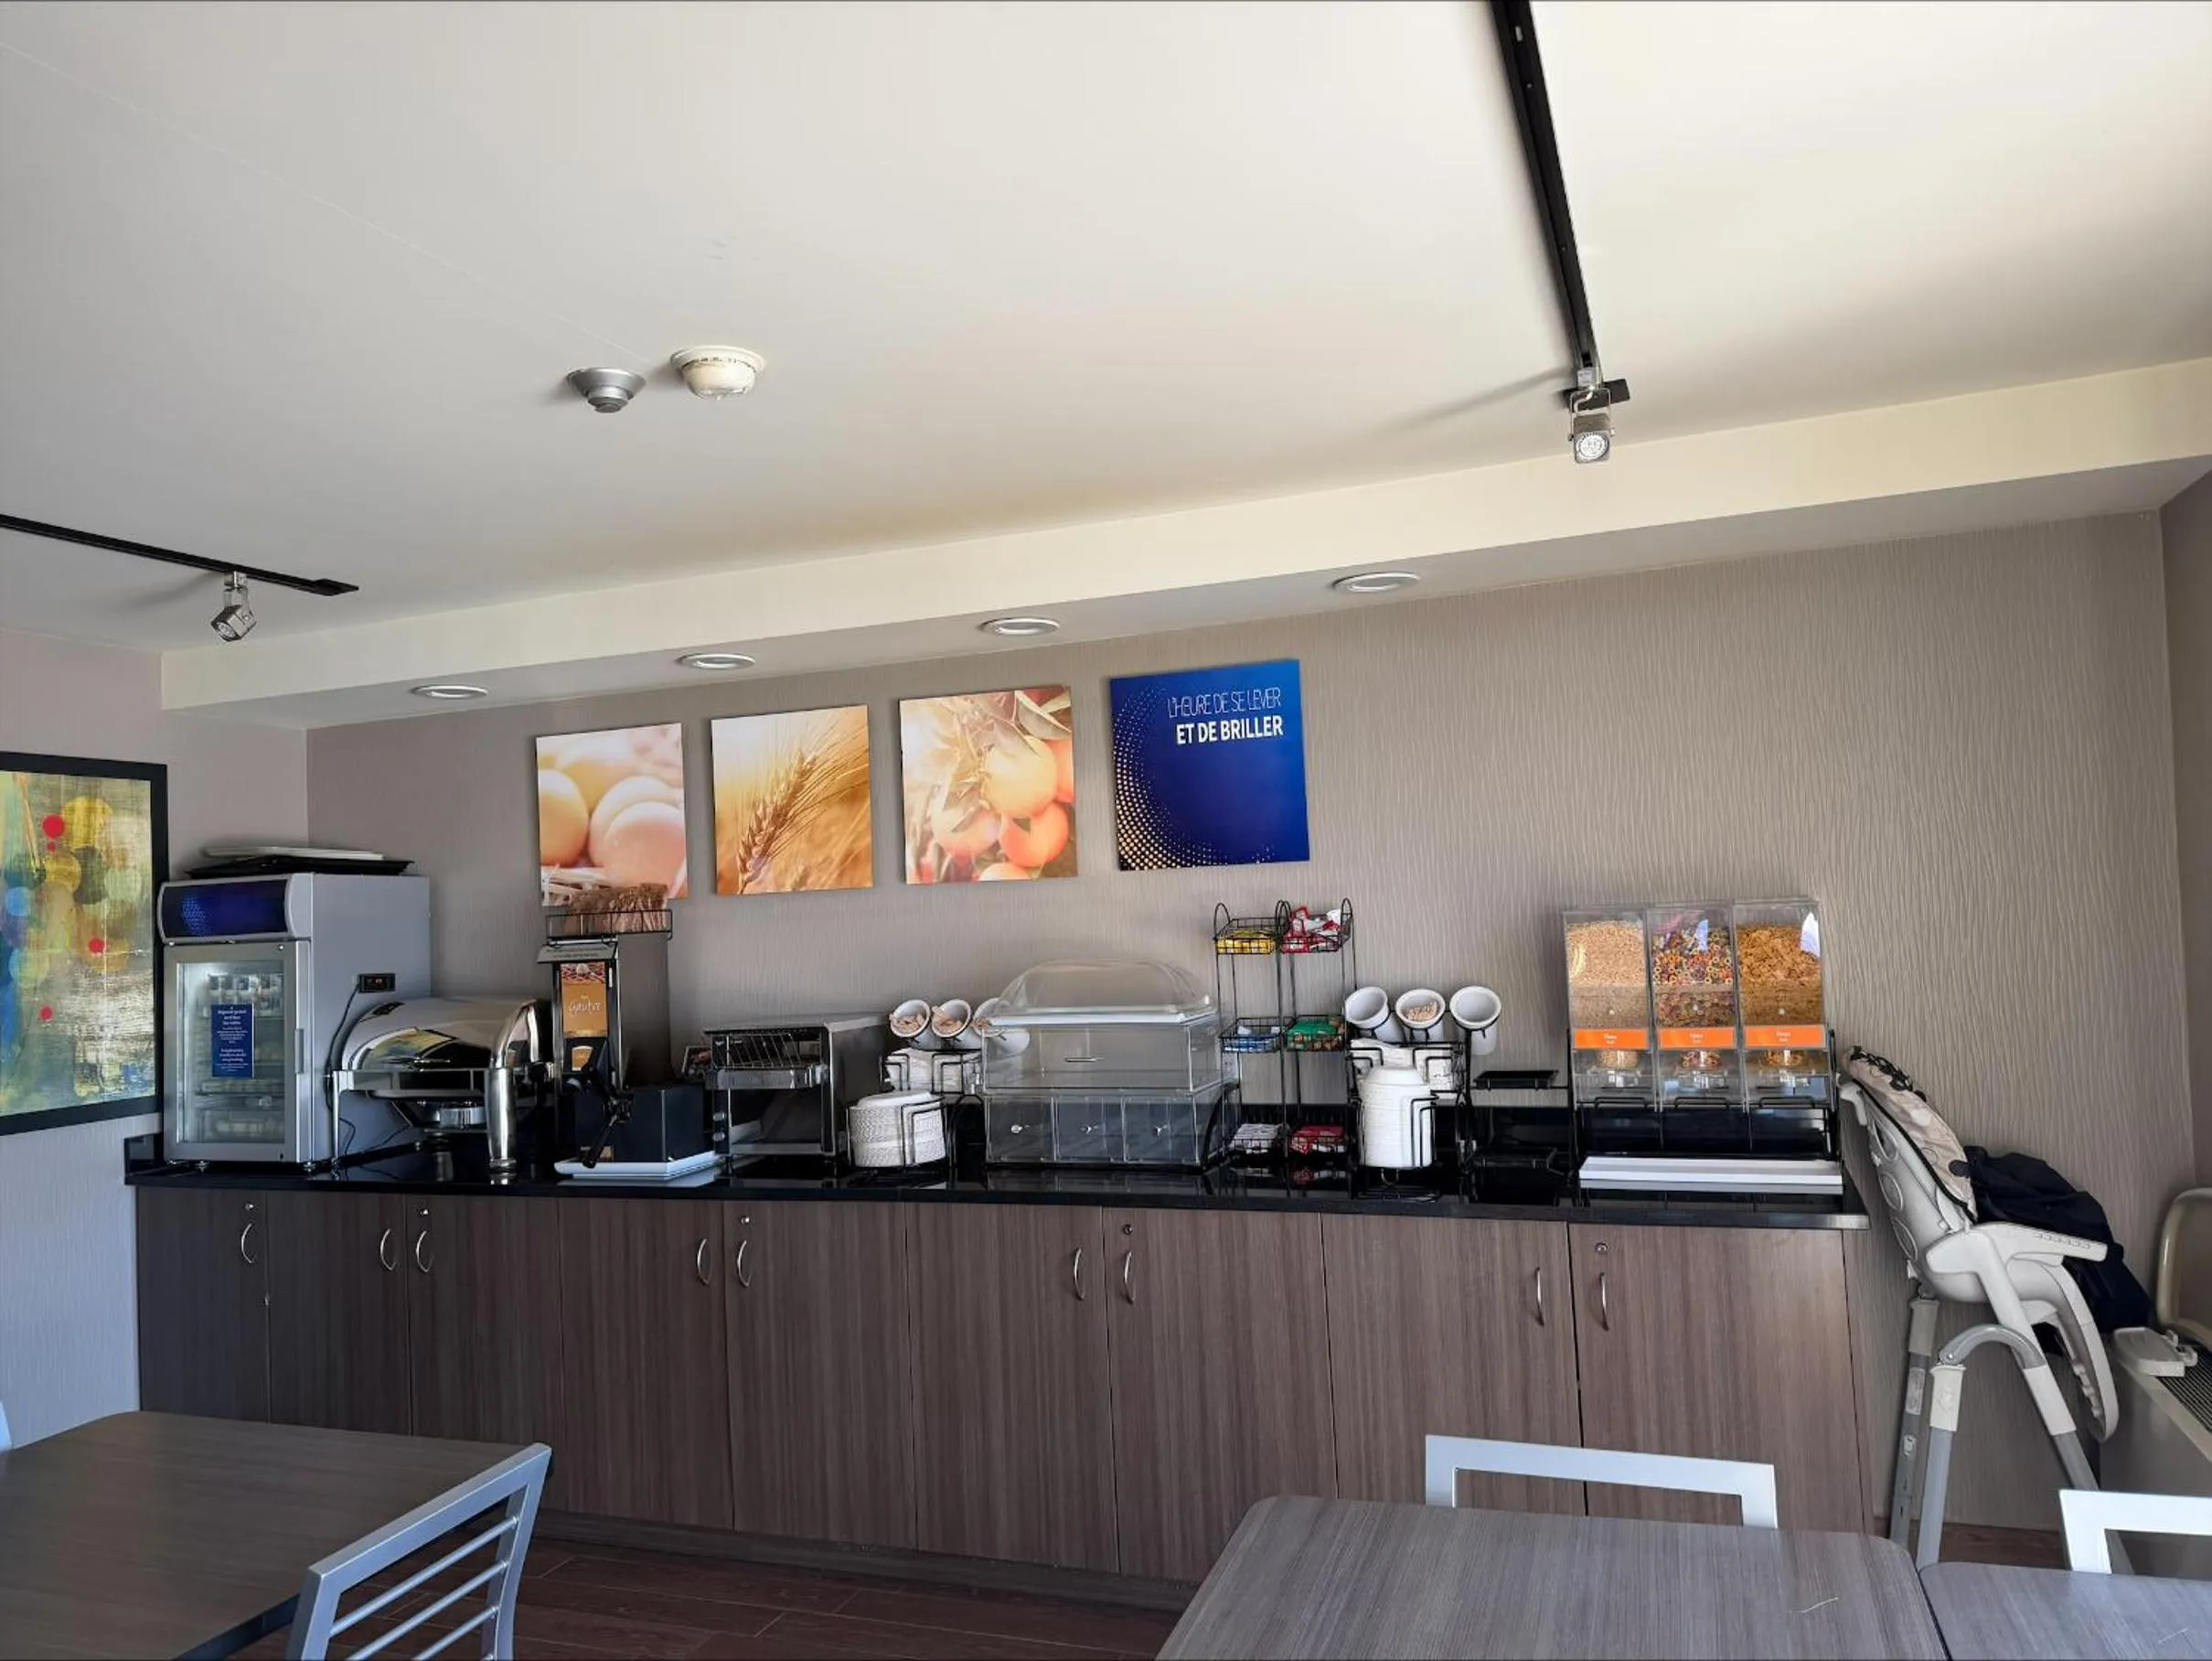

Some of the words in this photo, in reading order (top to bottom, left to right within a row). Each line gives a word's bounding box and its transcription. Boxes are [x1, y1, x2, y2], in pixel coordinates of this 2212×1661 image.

[1168, 694, 1212, 718] L'HEURE
[1213, 692, 1229, 713] DE
[1231, 691, 1245, 712] SE
[1247, 687, 1281, 711] LEVER
[1176, 723, 1194, 745] ET
[1197, 721, 1217, 743] DE
[1220, 714, 1283, 741] BRILLER
